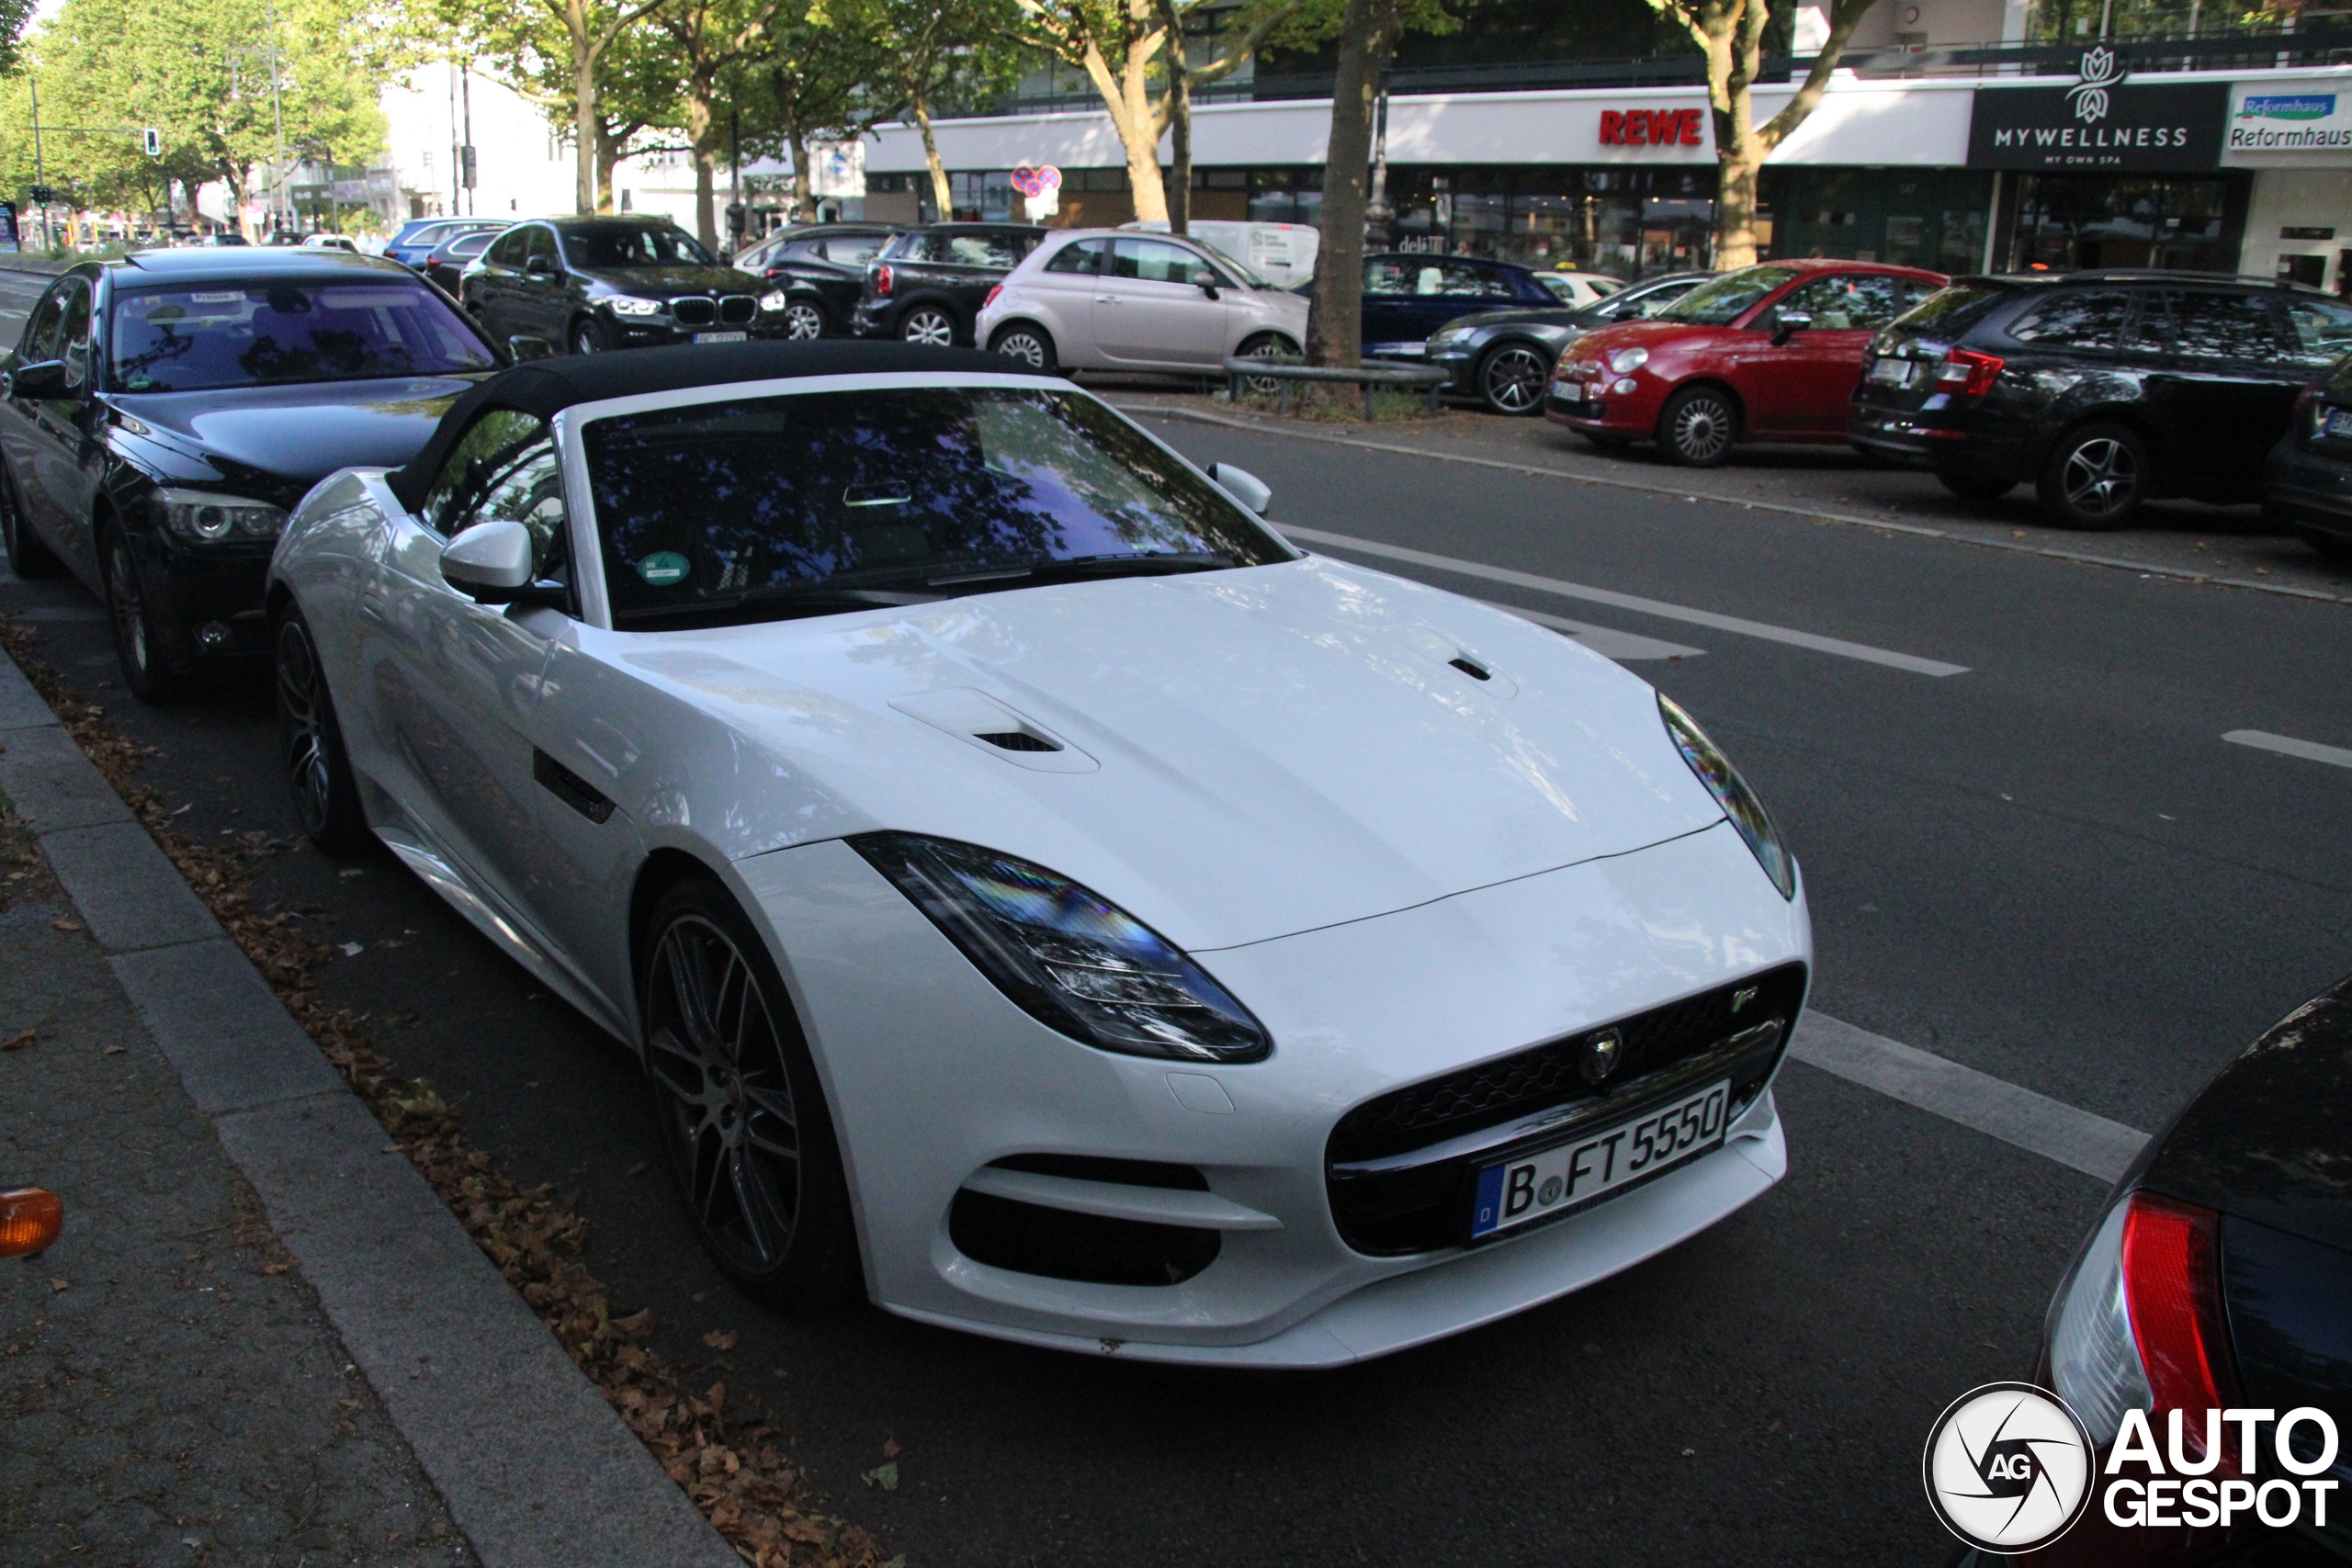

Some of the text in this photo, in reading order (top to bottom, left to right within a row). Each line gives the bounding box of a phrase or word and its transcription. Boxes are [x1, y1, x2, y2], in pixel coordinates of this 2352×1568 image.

[2245, 98, 2327, 117] Reformhaus
[1600, 108, 1702, 144] REWE
[1994, 128, 2188, 146] MYWELLNESS
[2230, 127, 2352, 147] Reformhaus
[2044, 155, 2121, 164] MY OWN SPA
[1505, 1164, 1536, 1218] B
[1566, 1132, 1626, 1197] FT
[1631, 1089, 1724, 1171] 5550
[1480, 1207, 1490, 1223] D
